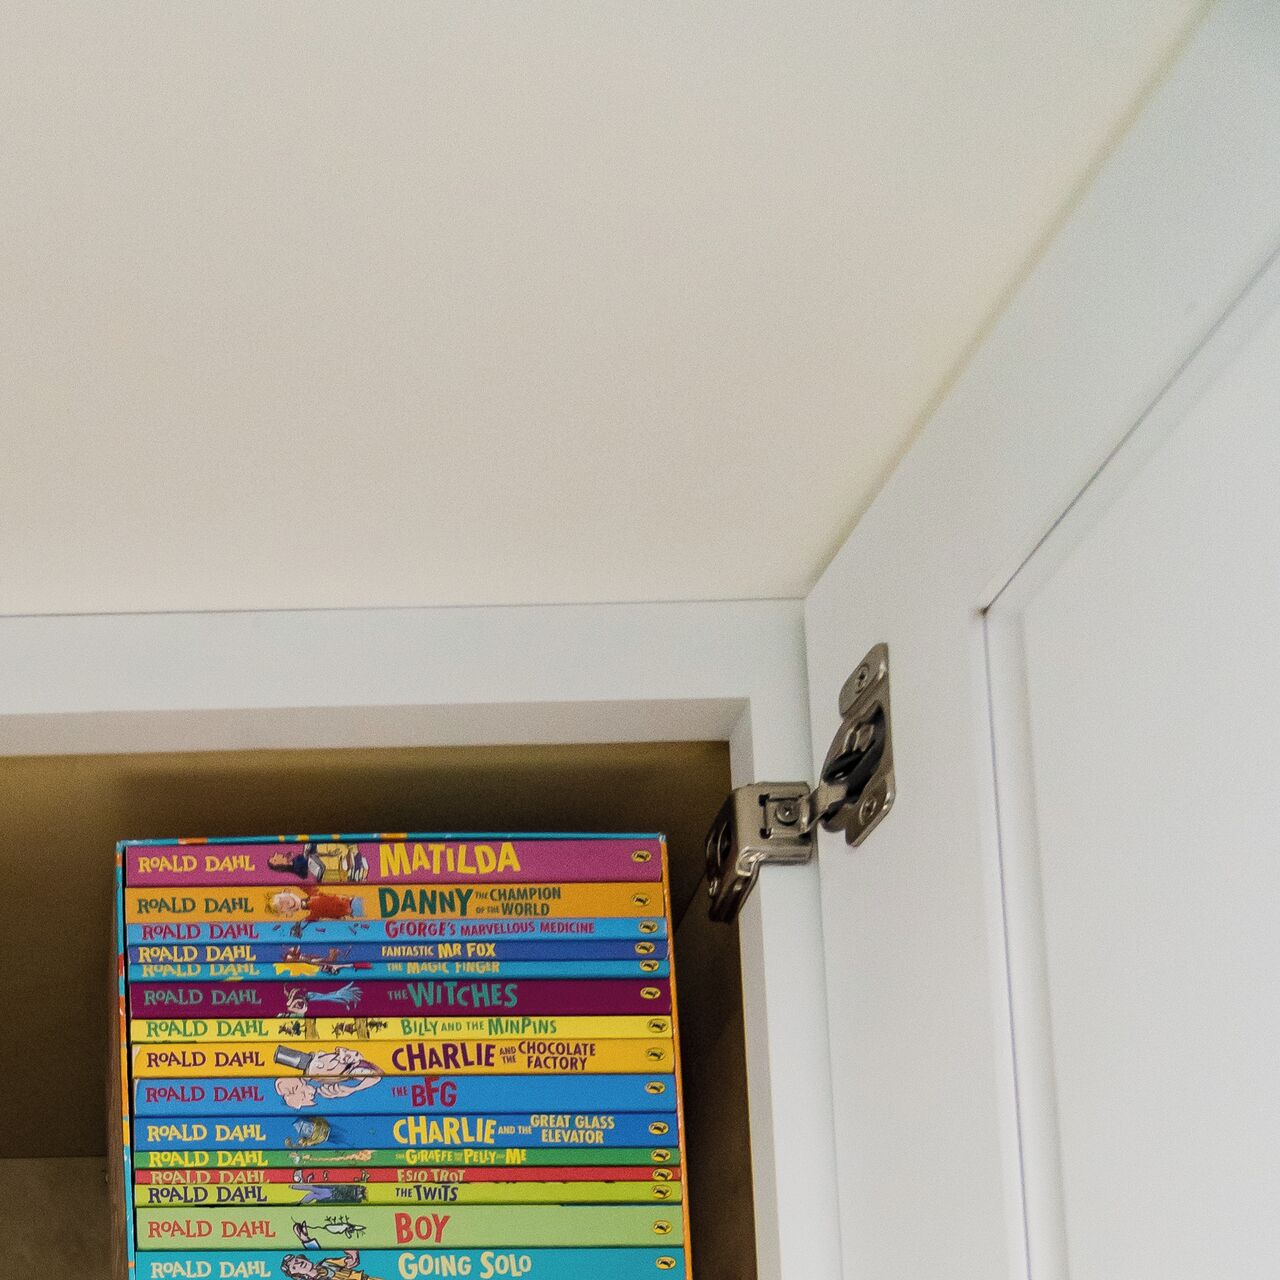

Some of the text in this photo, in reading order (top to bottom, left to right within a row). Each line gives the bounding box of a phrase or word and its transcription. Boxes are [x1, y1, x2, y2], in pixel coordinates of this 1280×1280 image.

[139, 842, 520, 877] ROALD DAHL MATILDA
[138, 887, 473, 918] ROALD DAHL DANNY
[143, 920, 594, 939] ROALD DAHL GEORGE'S MARVELLOUS MEDICINE
[145, 984, 517, 1008] ROALD DAHL THE WITCHES
[147, 1043, 495, 1073] ROALD DAHL CHARLIE
[519, 1042, 595, 1057] CHOCOLATE
[528, 1055, 588, 1071] FACTORY
[148, 1213, 451, 1243] ROALD DAHL BOY
